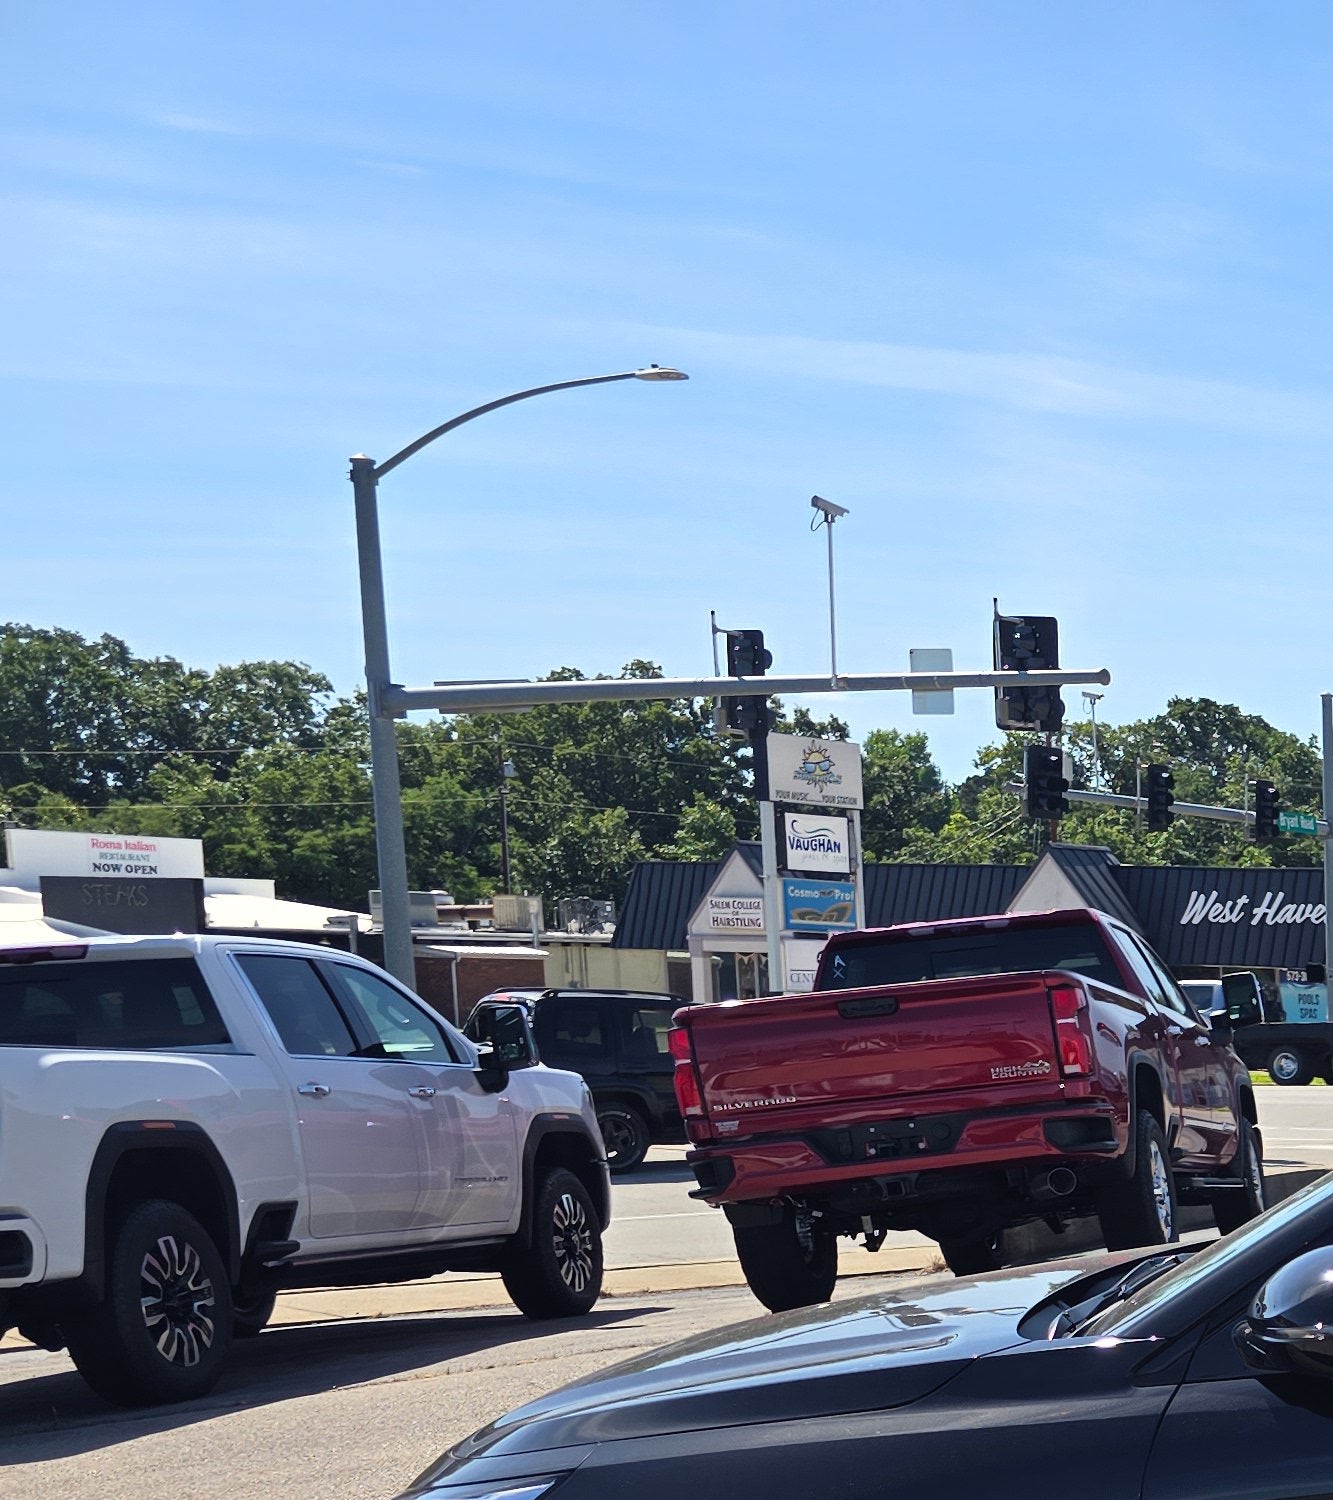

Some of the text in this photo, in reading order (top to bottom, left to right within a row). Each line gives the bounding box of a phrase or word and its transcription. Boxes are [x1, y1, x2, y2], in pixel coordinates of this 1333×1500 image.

[1280, 812, 1299, 830] Bryant
[91, 838, 157, 852] Roma Italian
[788, 836, 841, 853] VAUGHAN
[99, 852, 151, 862] RESTAURANT
[92, 862, 158, 874] NOW OPEN
[788, 886, 820, 898] Cosmo
[710, 900, 761, 910] SALEM COLLEGE
[1179, 890, 1250, 925] West
[712, 916, 761, 927] HAIRSTYLING
[1298, 994, 1320, 1006] POOLS
[1300, 1008, 1318, 1019] SPAS
[992, 1067, 1045, 1080] COUNTRY
[713, 1096, 797, 1112] SILVERADO
